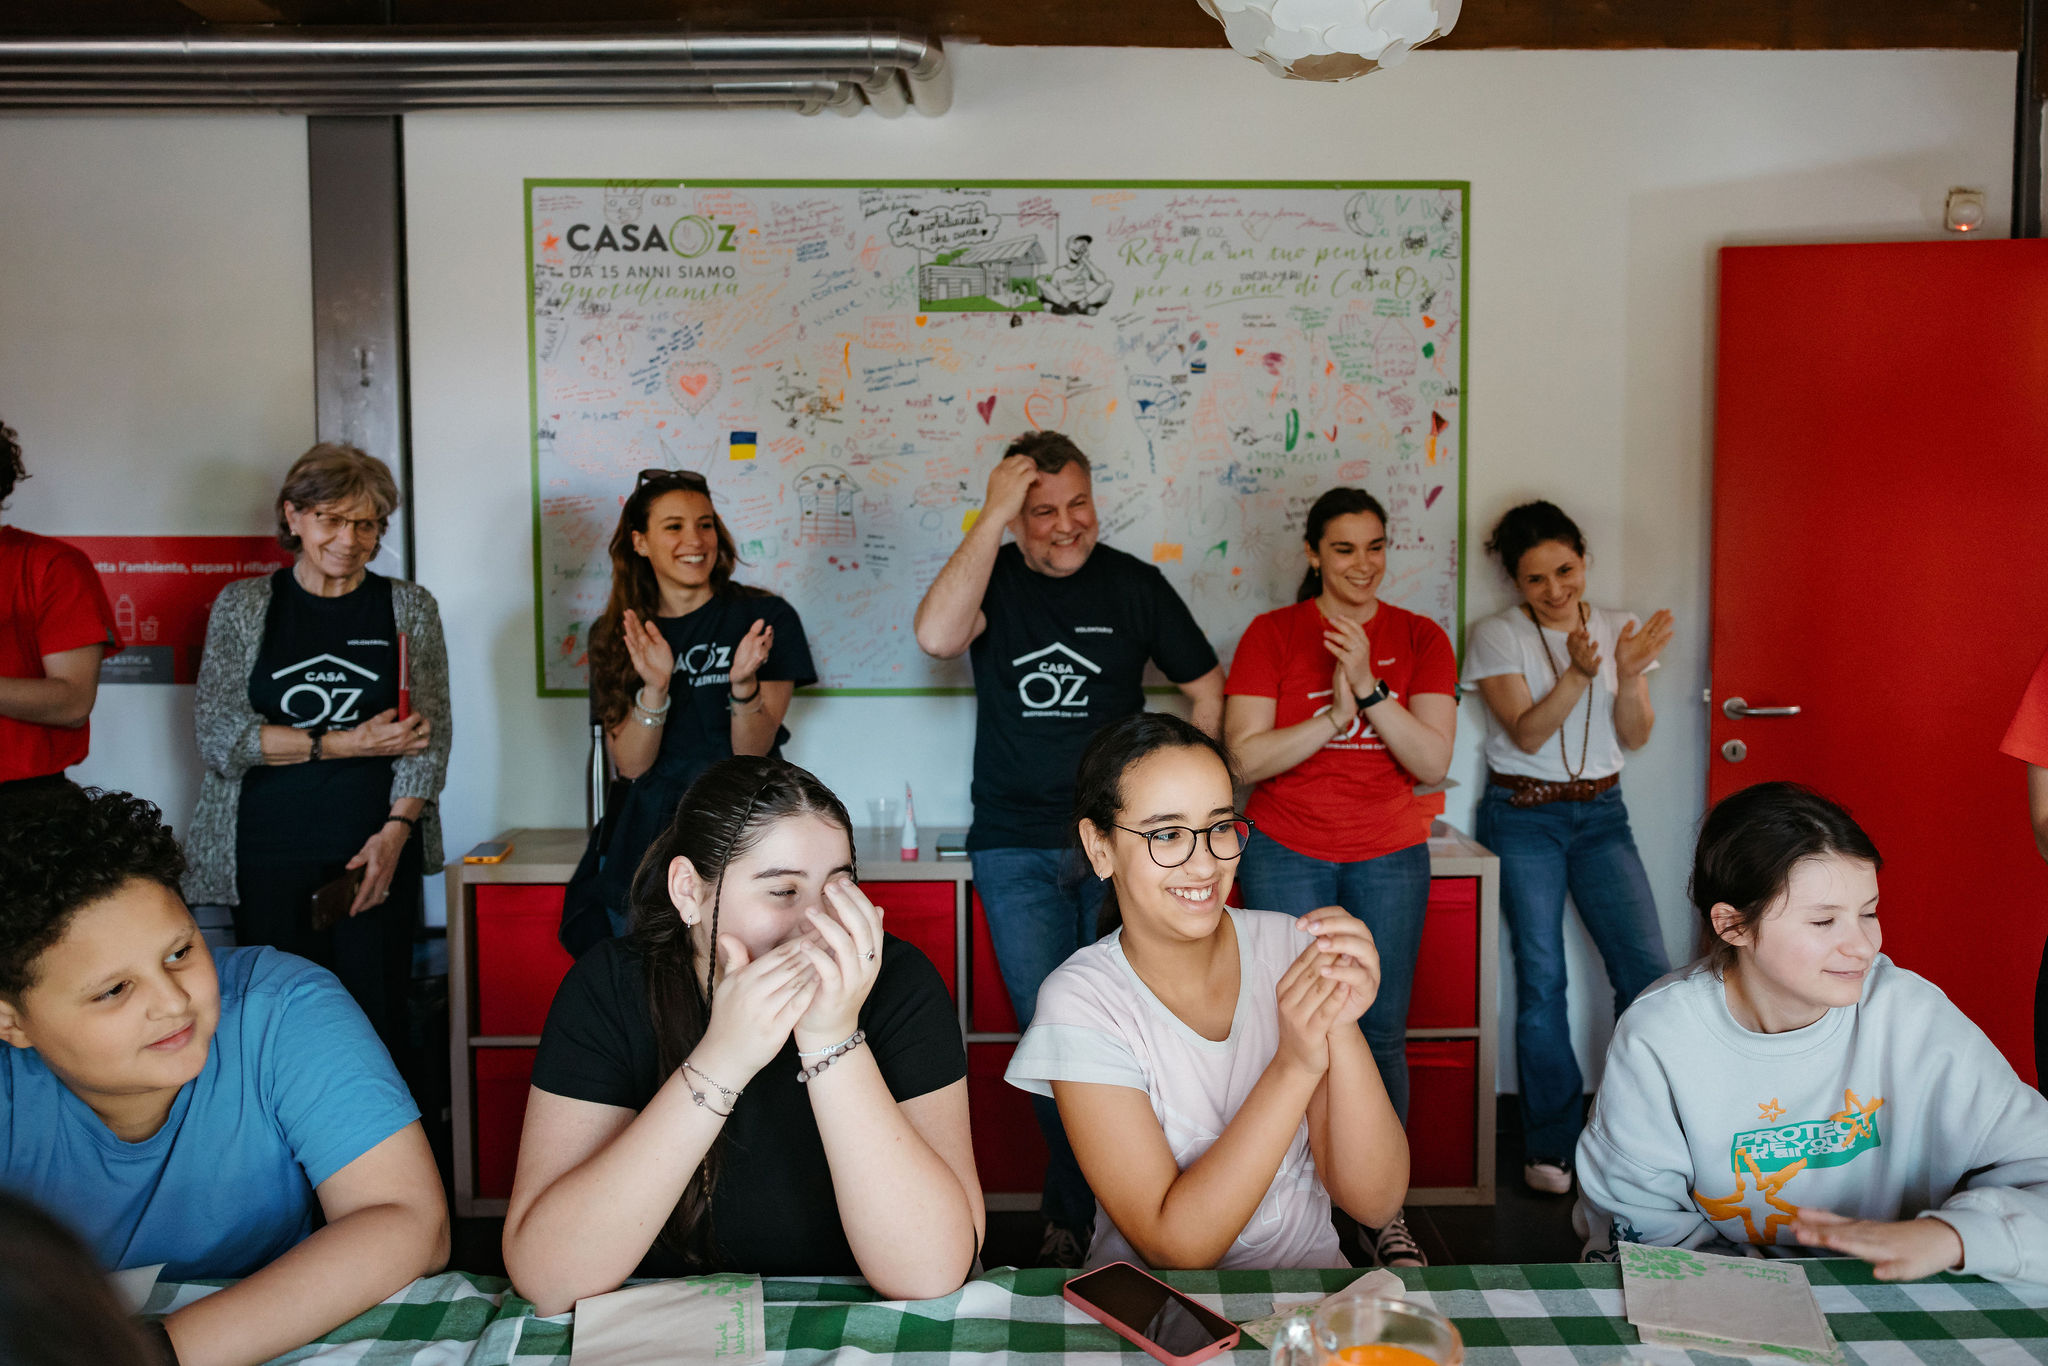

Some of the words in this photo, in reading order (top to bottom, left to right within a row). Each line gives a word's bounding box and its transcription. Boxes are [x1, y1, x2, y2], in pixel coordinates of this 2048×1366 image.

[1117, 235, 1215, 280] Regala
[1270, 245, 1306, 262] tuo
[570, 265, 593, 279] DA
[601, 265, 620, 279] 15
[626, 265, 671, 279] ANNI
[677, 265, 736, 279] SIAMO
[1132, 285, 1172, 306] per
[1203, 280, 1224, 297] 15
[119, 560, 189, 575] l'ambiente,
[191, 562, 234, 575] separa
[304, 671, 347, 683] CASA
[1039, 661, 1075, 675] CASA
[1018, 671, 1089, 709] OZ
[280, 683, 364, 726] OZ
